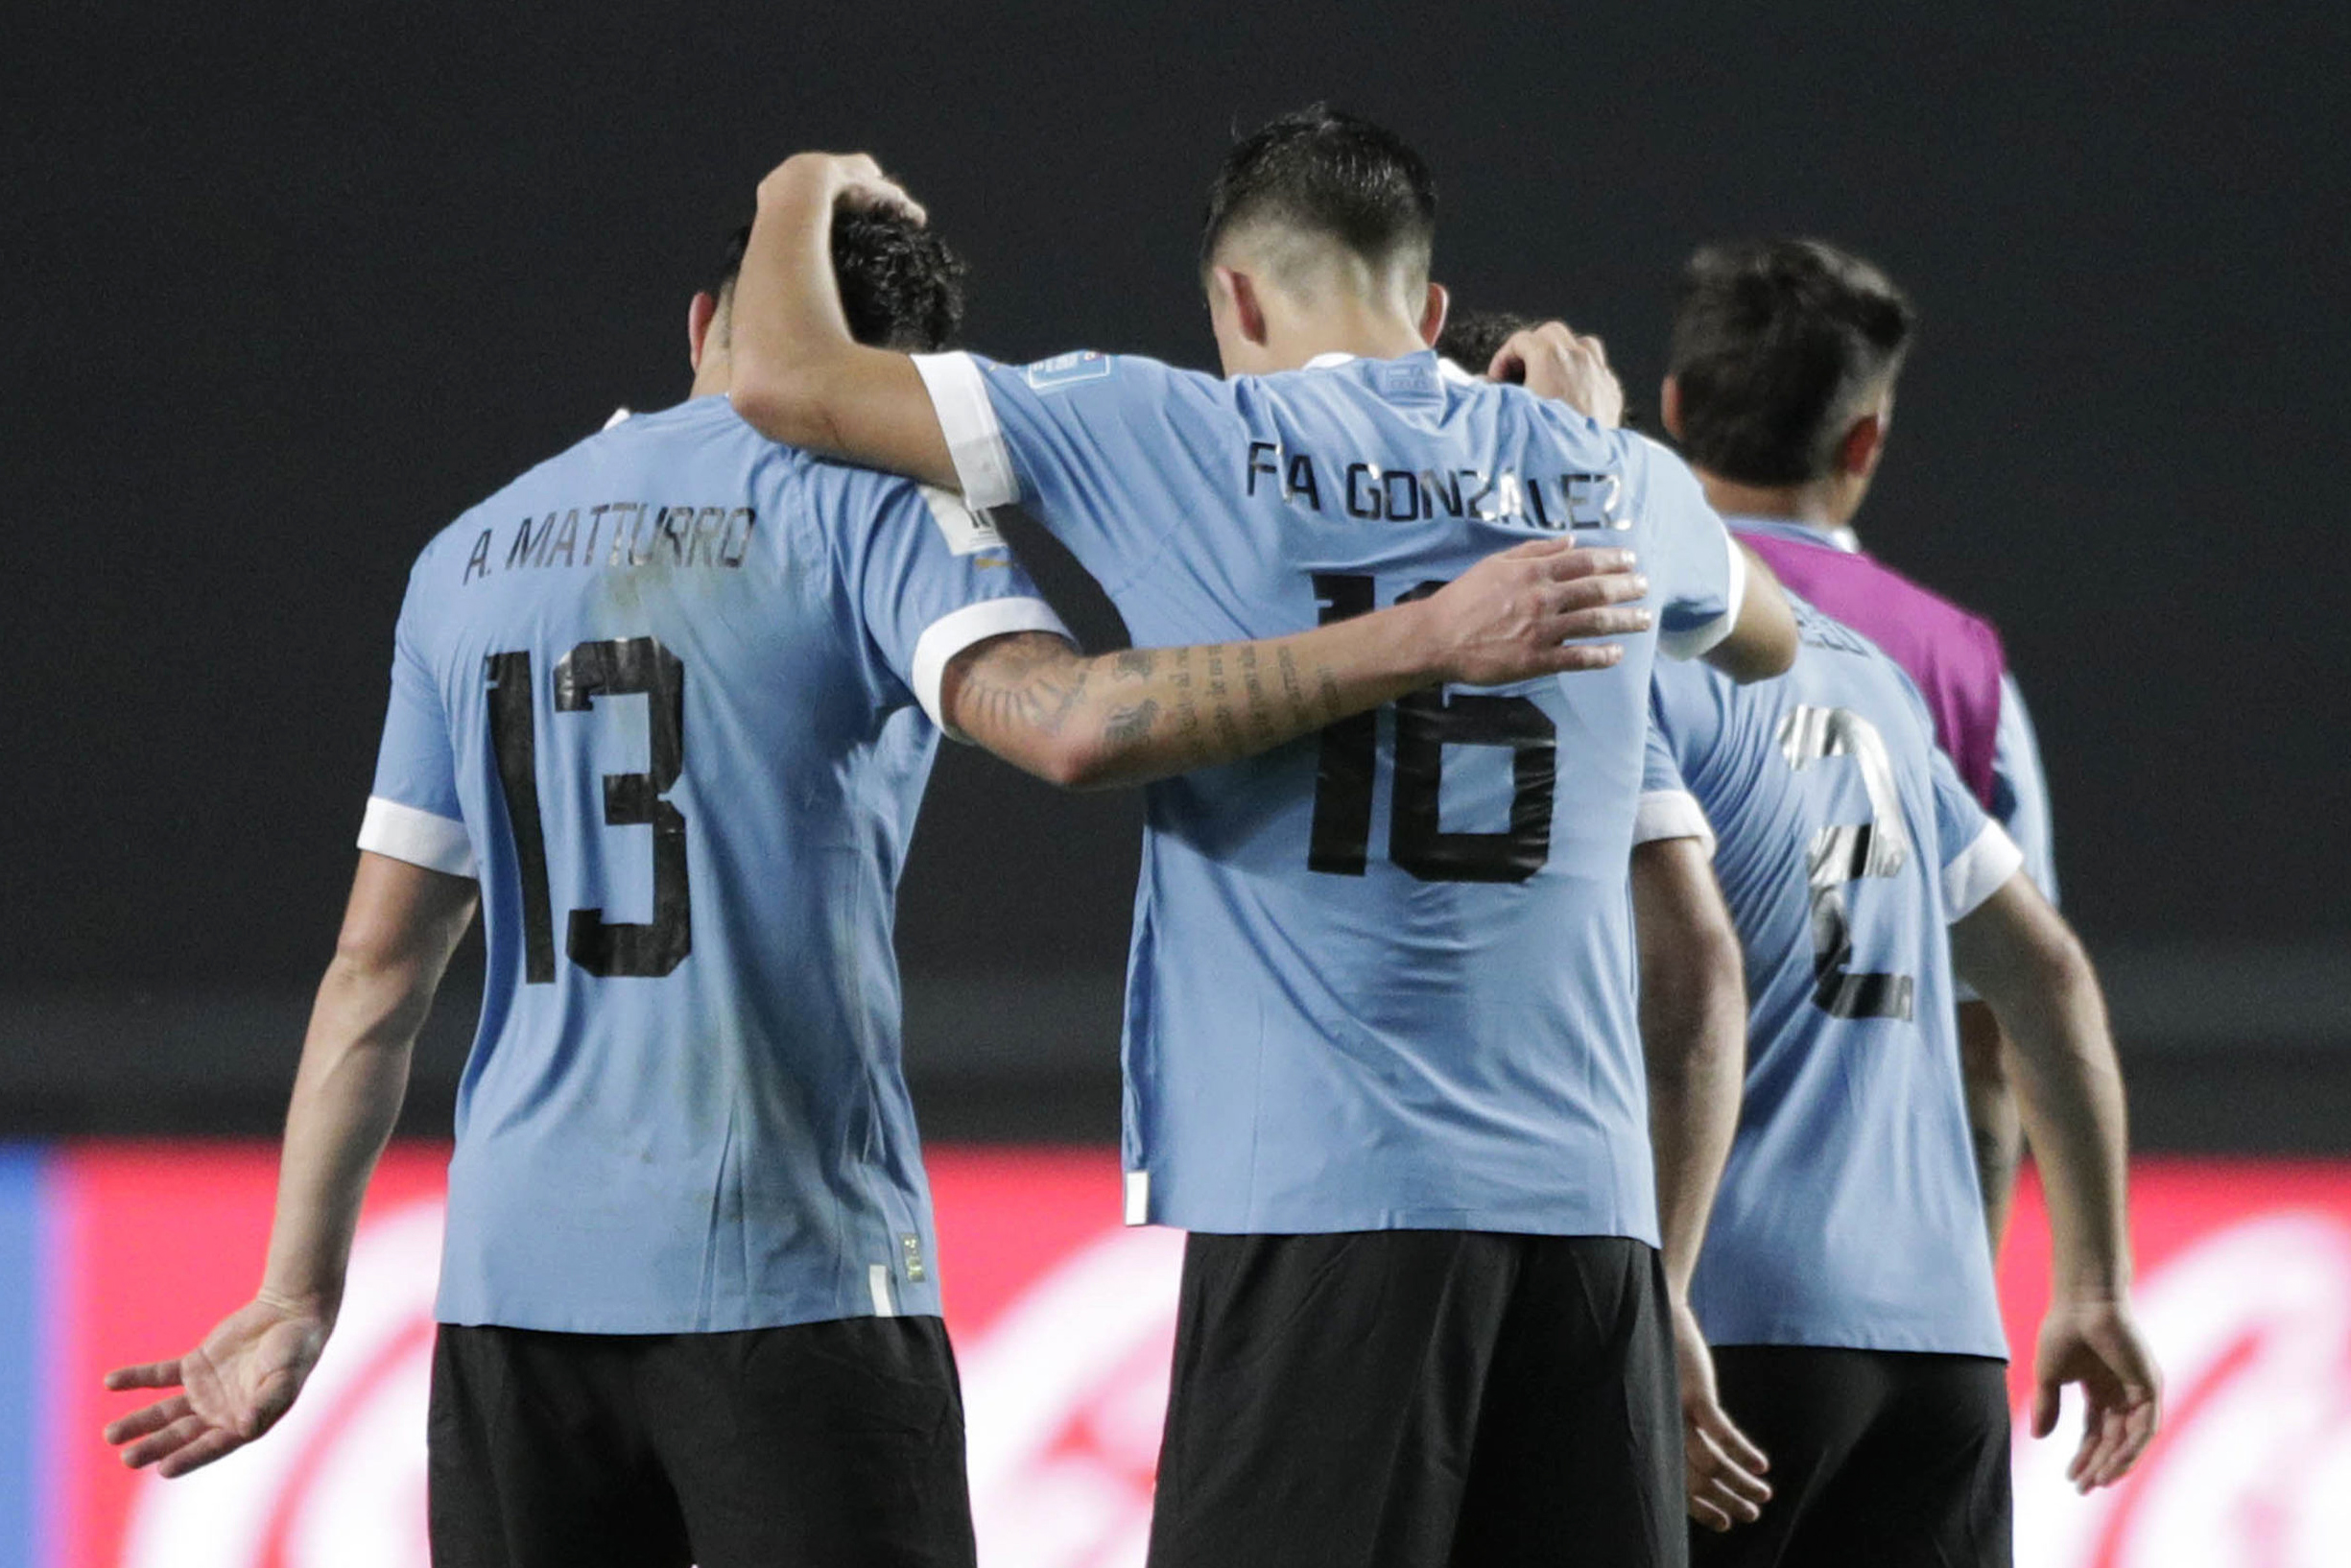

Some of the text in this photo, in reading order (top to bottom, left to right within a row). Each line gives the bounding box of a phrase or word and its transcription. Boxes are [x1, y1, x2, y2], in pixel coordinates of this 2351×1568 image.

[462, 502, 757, 585] A. MATTURRO
[1248, 441, 1632, 531] FA GONZALEZ
[486, 635, 693, 985] 13
[1308, 571, 1557, 884] 16
[1775, 702, 1915, 1022] 2
